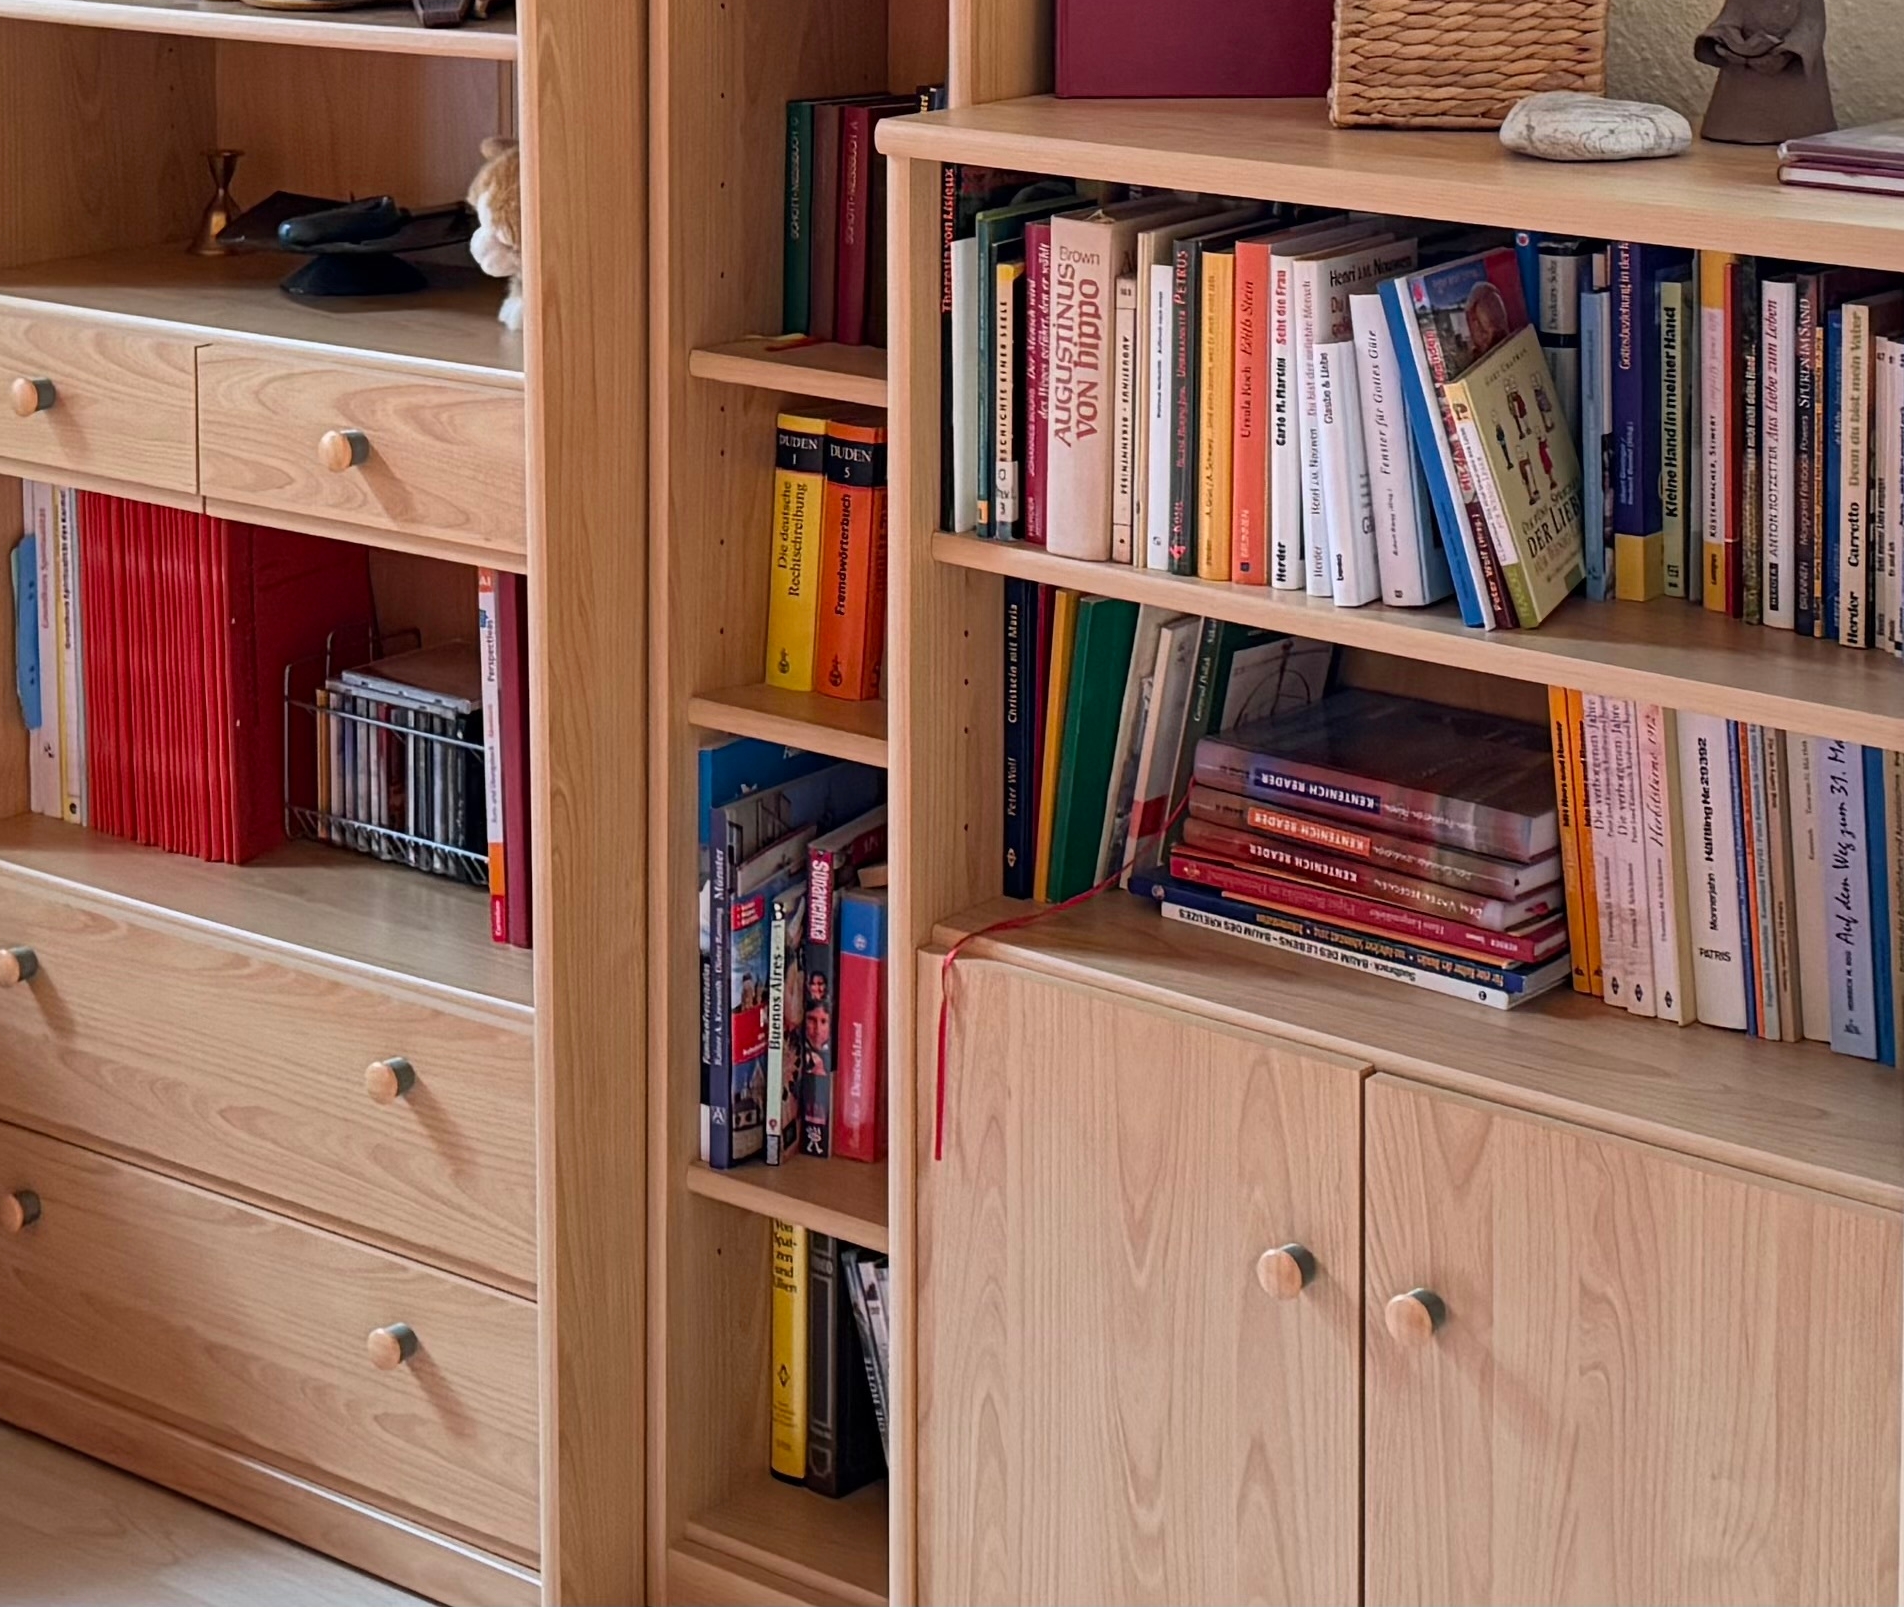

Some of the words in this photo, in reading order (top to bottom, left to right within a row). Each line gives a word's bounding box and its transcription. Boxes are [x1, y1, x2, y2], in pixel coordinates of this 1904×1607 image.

[942, 168, 955, 221] Lisieux
[944, 222, 954, 248] von
[1038, 243, 1049, 274] wählt
[1059, 246, 1101, 267] Brown
[1618, 254, 1631, 271] der
[942, 251, 953, 313] Theresia
[1039, 279, 1049, 291] er
[1173, 250, 1188, 305] PETRUS
[1275, 270, 1287, 296] Frau
[1329, 265, 1357, 288] Henri
[1619, 273, 1631, 284] in
[1026, 279, 1037, 307] wird
[1038, 294, 1049, 315] den
[1240, 280, 1254, 316] Stein
[1275, 298, 1287, 317] die
[1301, 280, 1314, 319] Mensch
[999, 300, 1008, 338] SEELE
[1026, 310, 1037, 355] Mensch
[1073, 278, 1103, 371] hippo
[1275, 319, 1287, 346] Seht
[1618, 284, 1632, 370] Gottesbeziehung
[1663, 306, 1677, 350] Hand
[1764, 298, 1779, 339] Leben
[1797, 298, 1811, 335] SAND
[1847, 311, 1862, 352] Vater
[1240, 318, 1254, 356] Edith
[1366, 329, 1380, 360] Güte
[1797, 336, 1811, 356] IM
[999, 344, 1008, 383] EINER
[1026, 358, 1037, 380] Der
[1052, 262, 1076, 448] AUGUSTINUS
[1319, 351, 1331, 378] Liebe
[1765, 340, 1779, 373] zum
[1240, 366, 1253, 397] Koch
[1275, 357, 1287, 399] Martini
[1369, 363, 1383, 404] Gottes
[1664, 352, 1677, 414] meiner
[1797, 357, 1811, 409] SPUREN
[1847, 354, 1861, 393] mein
[1305, 384, 1316, 400] bist
[1320, 390, 1334, 424] Glaube
[1765, 376, 1779, 412] Liebe
[999, 388, 1008, 462] ESCHICHTE
[1074, 379, 1099, 441] VON
[1240, 400, 1253, 439] Ursula
[1374, 406, 1388, 428] für
[1664, 417, 1677, 427] in
[1847, 394, 1861, 424] bist
[779, 434, 818, 450] DUDEN
[1275, 416, 1287, 447] Carlo
[1765, 413, 1779, 443] Aus
[1799, 415, 1809, 451] Powers
[1847, 427, 1861, 445] du
[830, 443, 872, 463] DUDEN
[1376, 430, 1392, 475] Fenster
[1664, 428, 1678, 469] Hand
[844, 466, 851, 479] 5
[1767, 446, 1778, 511] ROTZETTER
[1847, 447, 1861, 487] Denn
[1308, 487, 1321, 515] Henri
[1664, 469, 1679, 518] Kleine
[778, 481, 792, 542] deutsche
[1799, 498, 1811, 546] Margaret
[788, 482, 807, 597] Rechtschreibung
[1526, 528, 1553, 559] DER
[1767, 514, 1778, 558] ANTON
[1846, 502, 1861, 568] Carretto
[777, 544, 788, 569] Die
[834, 494, 852, 616] Fremdwörterbuch
[1275, 541, 1287, 583] Herder
[1312, 545, 1324, 578] Herder
[1480, 549, 1495, 578] Wolf
[1487, 580, 1503, 612] Peter
[1007, 604, 1018, 639] Maria
[1846, 591, 1860, 645] Herder
[1007, 642, 1018, 663] mit
[1007, 667, 1018, 724] Christsein
[1585, 698, 1599, 730] Jahre
[1609, 703, 1623, 734] Jahre
[1697, 737, 1709, 787] 29392
[1827, 740, 1845, 764] Ma
[1006, 757, 1017, 785] Wolf
[1261, 772, 1306, 796] READER
[1558, 760, 1567, 782] und
[1587, 735, 1603, 804] verborgenen
[1611, 740, 1627, 811] verborgenen
[1829, 771, 1847, 795] 31.
[1007, 787, 1017, 816] Peter
[1309, 782, 1375, 810] KENTENICH
[1254, 812, 1298, 837] READER
[1589, 810, 1604, 830] Die
[1614, 815, 1628, 836] Die
[1701, 806, 1714, 863] Häftling
[1837, 801, 1855, 839] zum
[1301, 822, 1364, 851] KENTENICH
[1249, 843, 1291, 866] READER
[1294, 854, 1358, 883] KENTENICH
[1831, 842, 1854, 869] Weg
[713, 848, 725, 901] Münster
[1706, 873, 1719, 932] Monnerjahn
[1833, 877, 1852, 911] dem
[1179, 908, 1223, 934] KREUZES
[1223, 919, 1243, 937] DES
[1243, 924, 1272, 945] BAUM
[1834, 915, 1858, 946] Auf
[1279, 934, 1318, 958] LEBENS
[1319, 944, 1340, 962] DES
[1340, 947, 1370, 970] BAUM
[1699, 947, 1731, 962] PATRIS
[769, 954, 783, 990] Aires
[1374, 961, 1417, 983] Sudbrack
[768, 996, 782, 1051] Buenos
[849, 1021, 863, 1097] Deutschland
